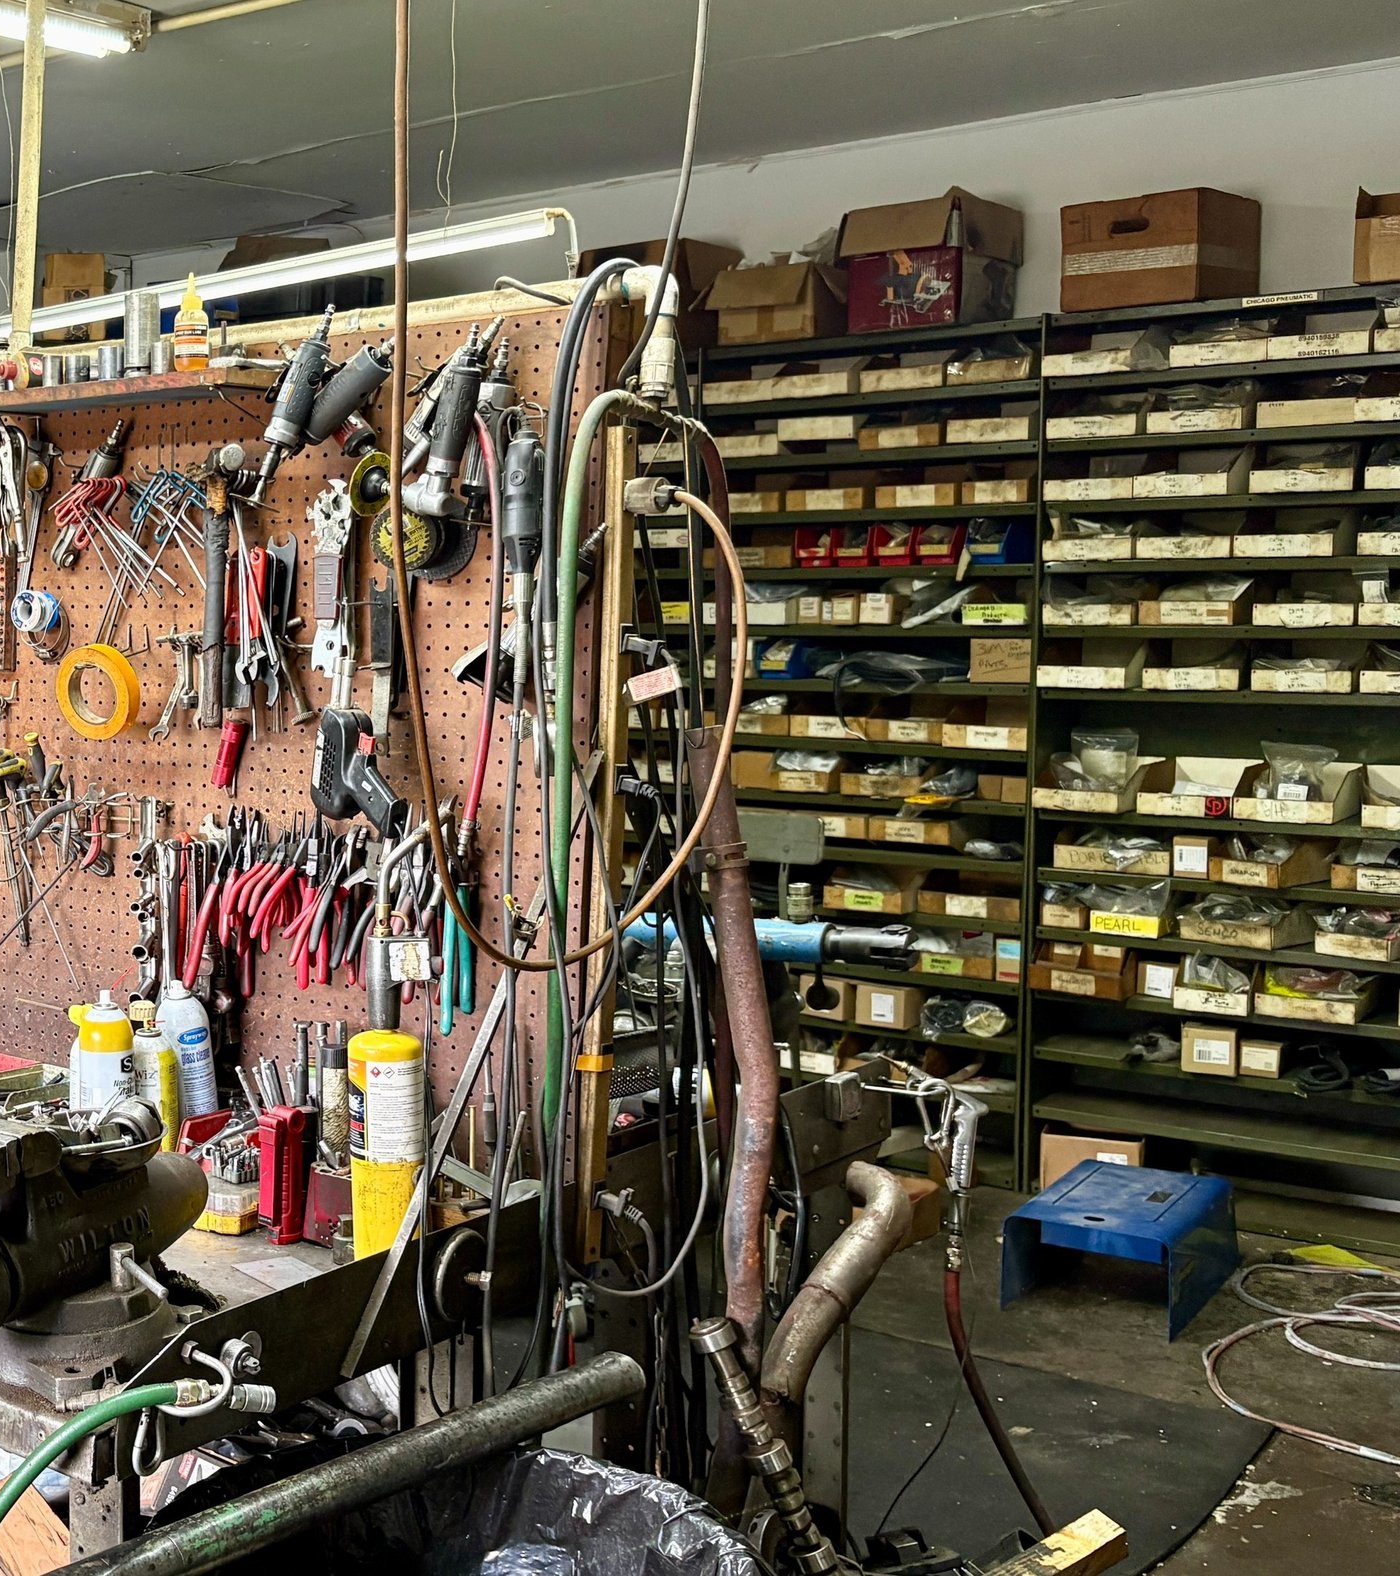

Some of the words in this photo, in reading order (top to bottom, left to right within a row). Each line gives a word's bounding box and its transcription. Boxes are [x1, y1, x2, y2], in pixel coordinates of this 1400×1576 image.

[1246, 297, 1275, 305] CHICAGO
[1275, 293, 1314, 303] PNEUMATIC
[1094, 916, 1141, 932] PEARL
[181, 1052, 196, 1066] glass
